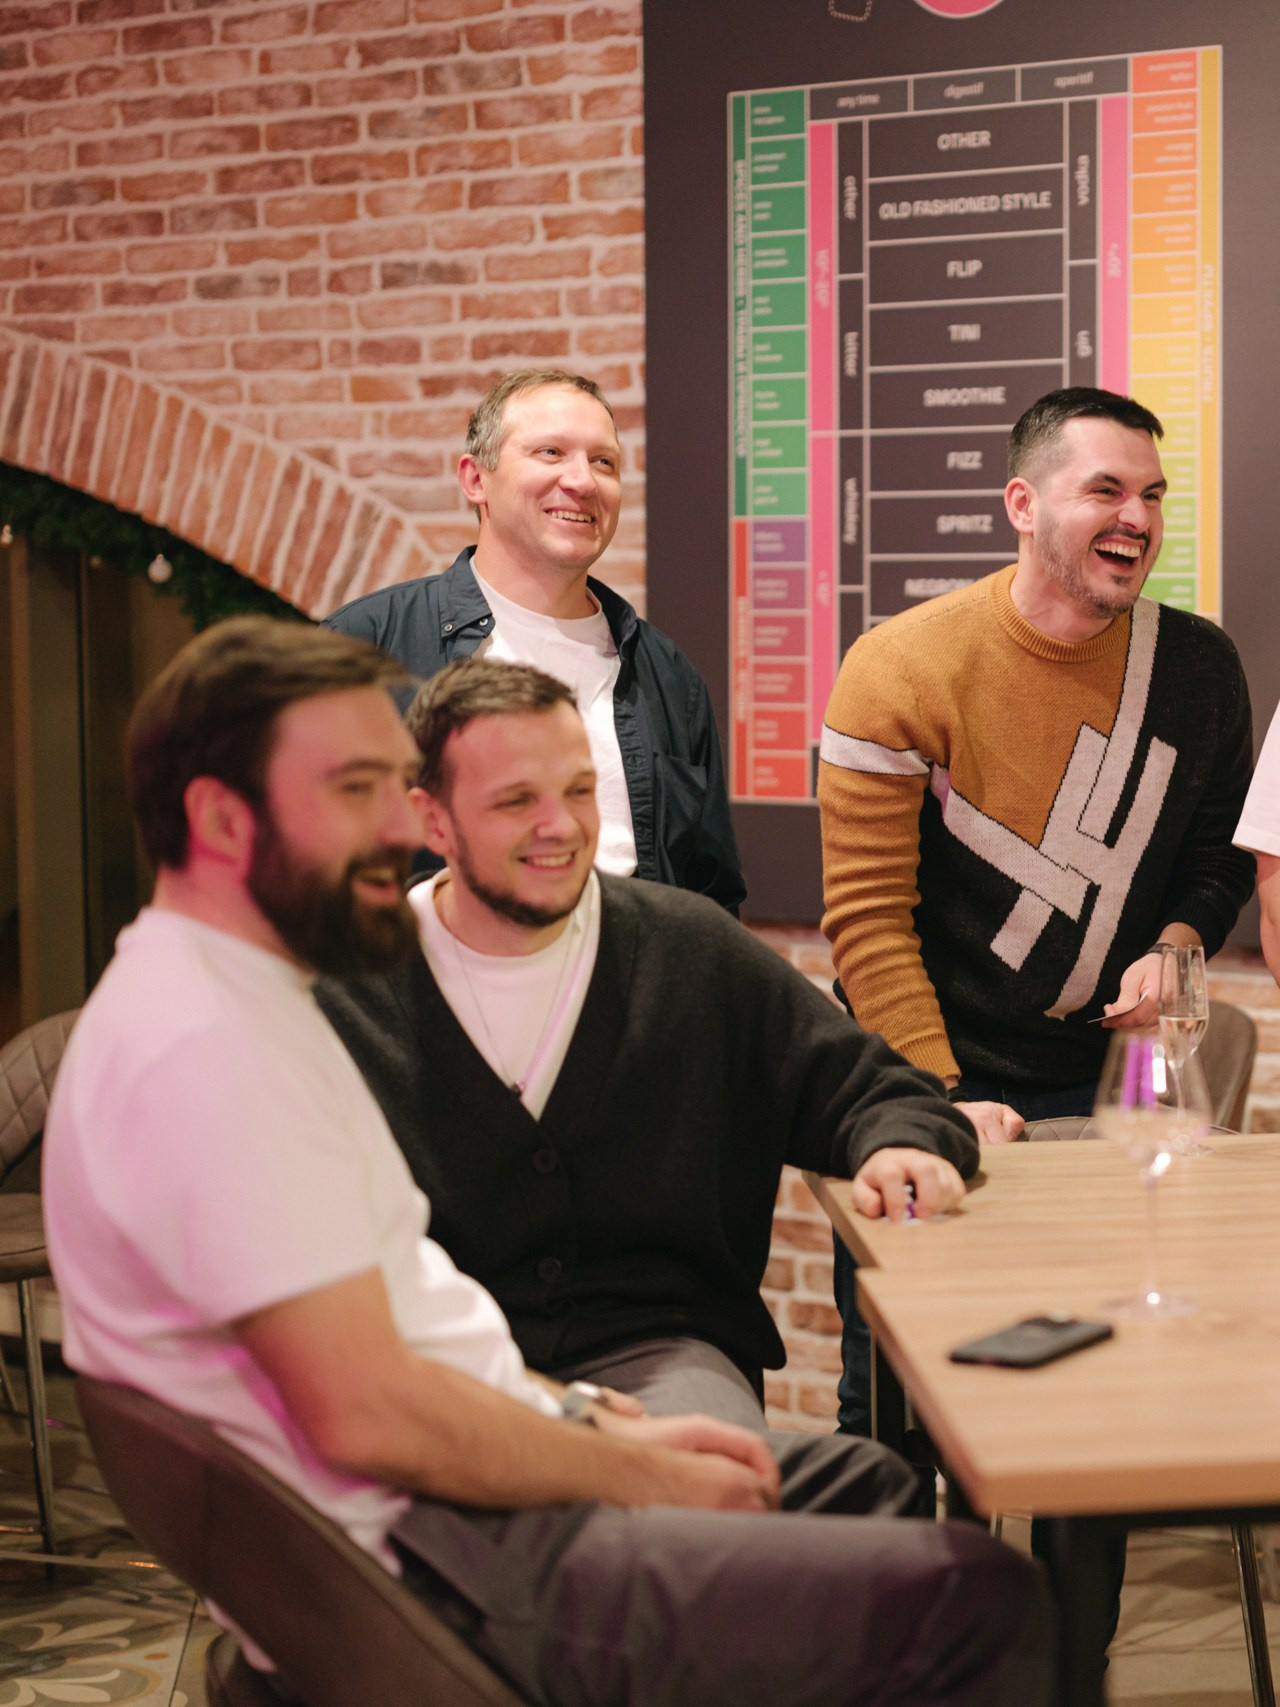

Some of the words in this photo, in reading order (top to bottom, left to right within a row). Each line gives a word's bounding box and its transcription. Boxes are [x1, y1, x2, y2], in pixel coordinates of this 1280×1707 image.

[936, 130, 992, 151] OTHER
[1074, 154, 1091, 207] vodka
[843, 175, 858, 220] other
[878, 201, 912, 220] OLD
[912, 194, 1000, 218] FASHIONED
[1000, 190, 1052, 212] STYLE
[946, 259, 983, 278] FLIP
[949, 324, 981, 342] TINI
[844, 331, 859, 377] bitter
[1075, 330, 1093, 358] gin
[923, 386, 1006, 407] SMOOTHIE
[947, 451, 983, 470] FIZZ
[936, 514, 993, 534] SPRITZ
